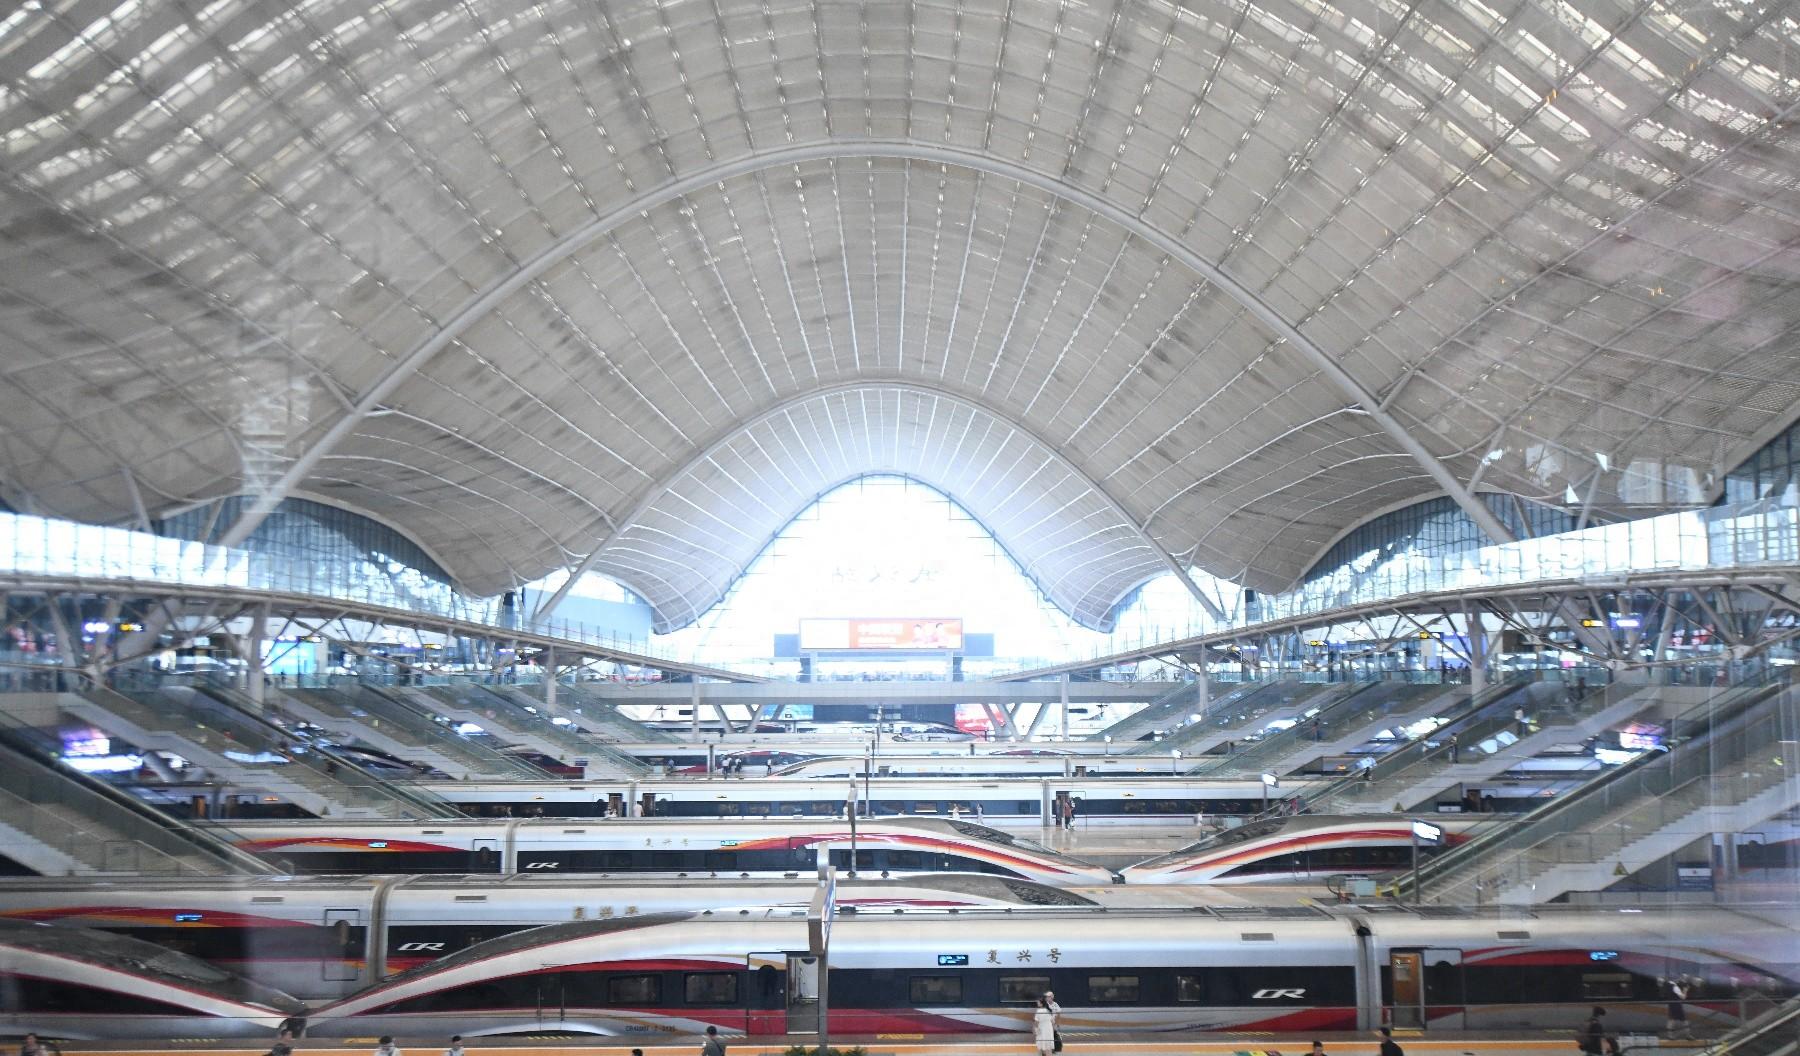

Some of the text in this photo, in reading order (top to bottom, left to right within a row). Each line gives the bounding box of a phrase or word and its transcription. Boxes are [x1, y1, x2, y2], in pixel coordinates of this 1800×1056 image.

[397, 942, 446, 950] CR
[987, 948, 1062, 964] 复兴号
[1252, 988, 1306, 999] CR
